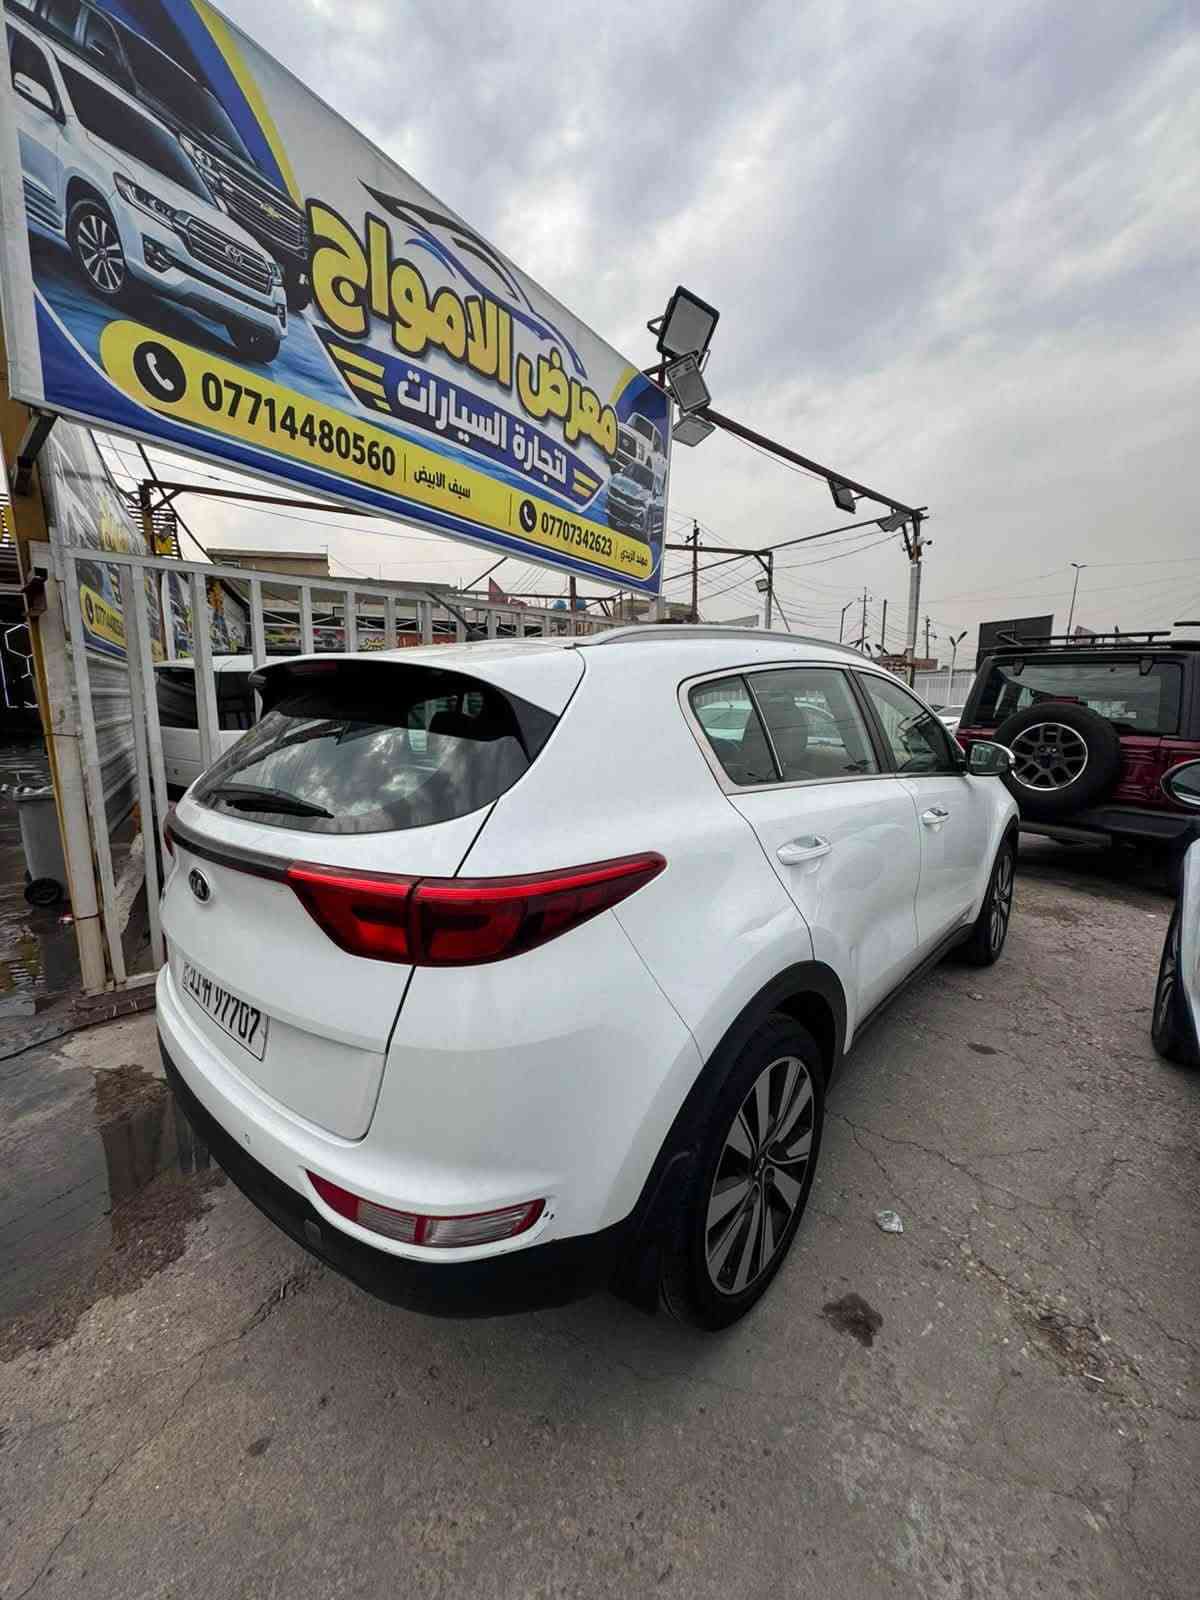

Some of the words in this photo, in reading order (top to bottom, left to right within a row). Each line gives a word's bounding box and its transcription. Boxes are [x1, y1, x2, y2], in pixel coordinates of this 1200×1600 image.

[304, 197, 513, 392] الامواج
[201, 371, 396, 476] 07714480560
[397, 370, 507, 451] السيارات
[516, 346, 617, 457] معرض
[448, 479, 471, 499] سيف
[512, 423, 568, 484] لتجارة
[540, 511, 613, 557] 07707342623
